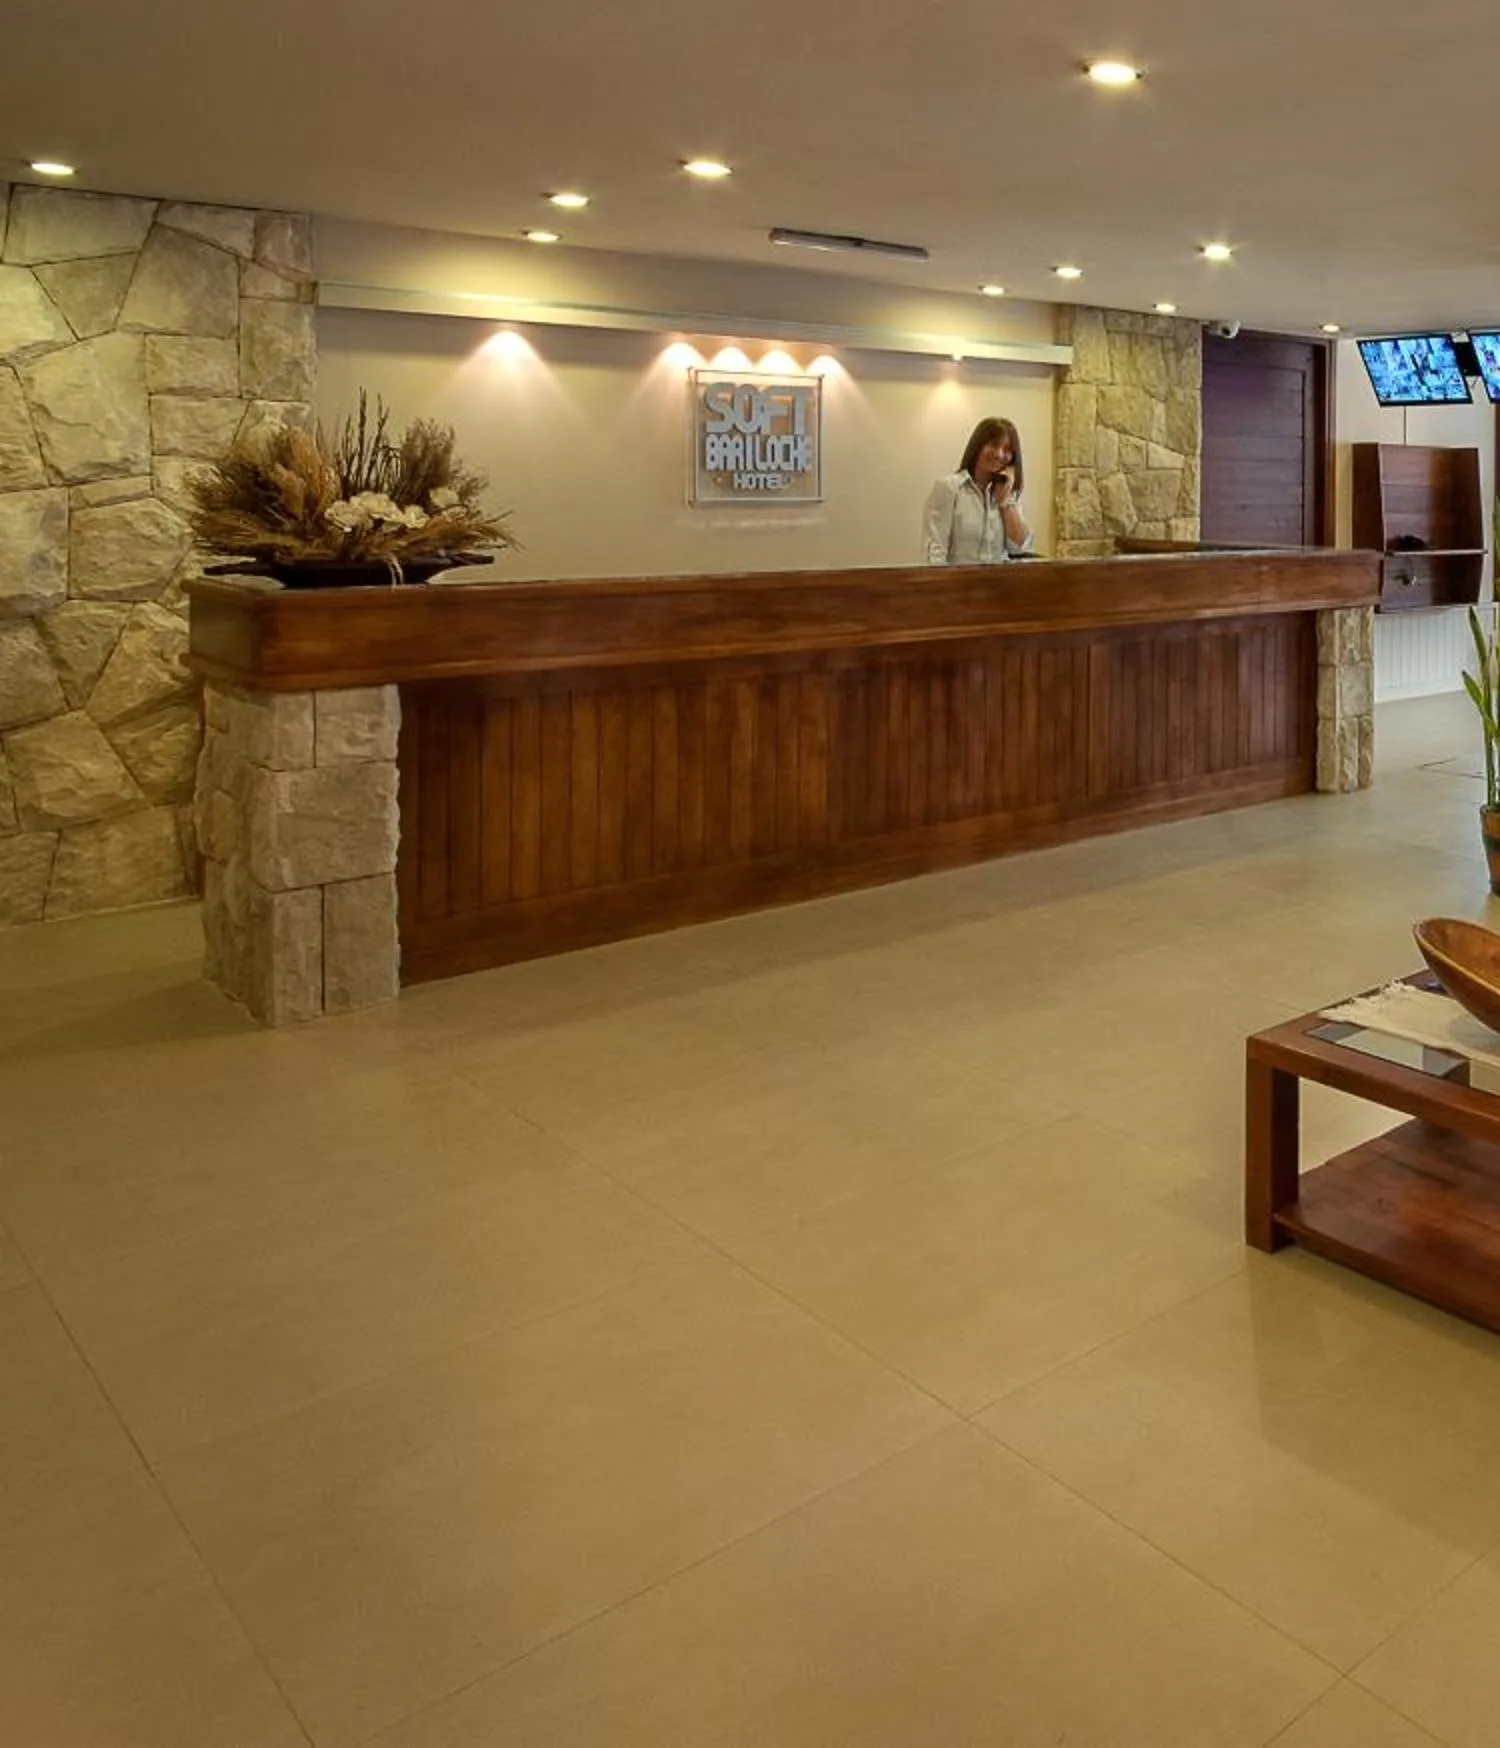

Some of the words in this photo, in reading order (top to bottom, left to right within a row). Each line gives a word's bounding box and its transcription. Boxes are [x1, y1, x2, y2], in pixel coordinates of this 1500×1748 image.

[704, 383, 813, 433] SOFT
[706, 434, 811, 472] BARILOCHE
[733, 473, 789, 489] HOTEL
